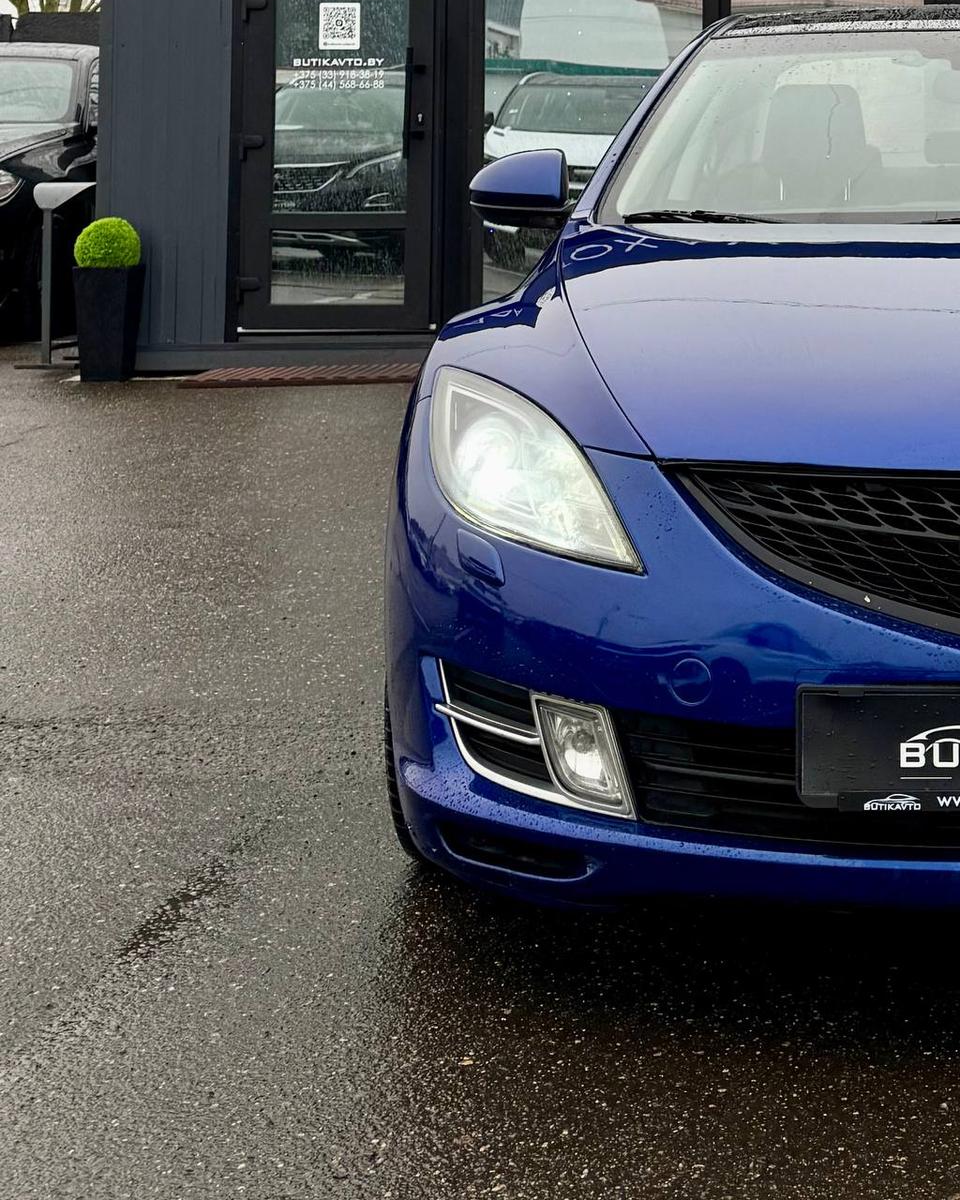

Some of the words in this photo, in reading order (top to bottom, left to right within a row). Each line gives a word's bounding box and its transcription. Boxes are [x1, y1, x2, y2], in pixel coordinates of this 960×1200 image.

[293, 58, 385, 67] BUTIKAVTO.BY
[294, 70, 316, 80] +375
[319, 70, 337, 81] (33)
[339, 70, 385, 80] 918-38-19
[293, 80, 316, 89] +375
[319, 80, 337, 90] (44)
[339, 80, 385, 89] 568-66-88
[863, 802, 921, 811] BUTIKAVTO
